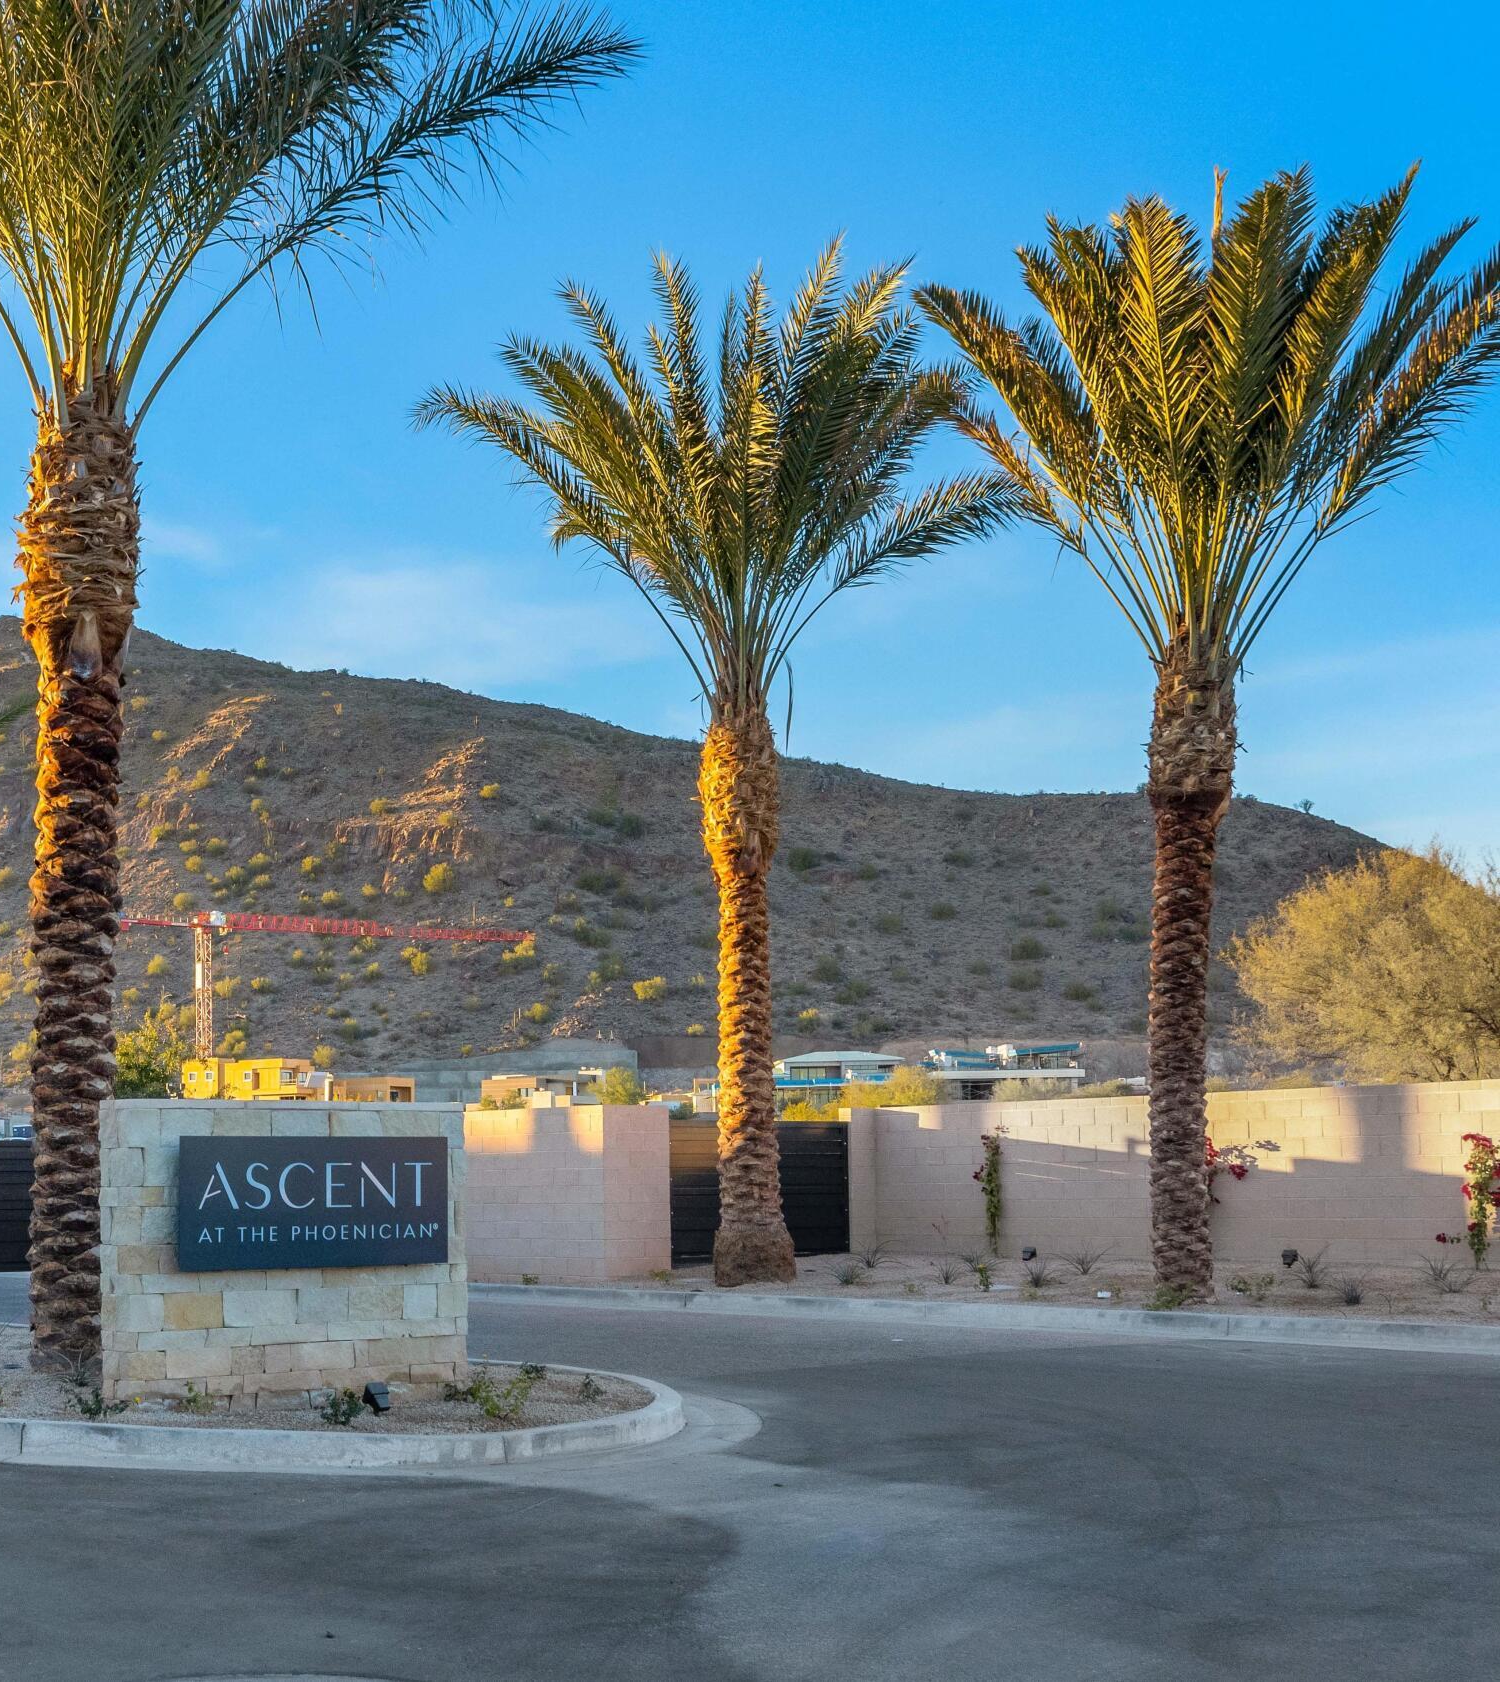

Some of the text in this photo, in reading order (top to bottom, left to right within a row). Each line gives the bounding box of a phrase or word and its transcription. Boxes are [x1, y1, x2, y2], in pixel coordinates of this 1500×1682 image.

[198, 1161, 433, 1210] ASCENT
[198, 1227, 225, 1244] AT
[237, 1226, 278, 1242] THE
